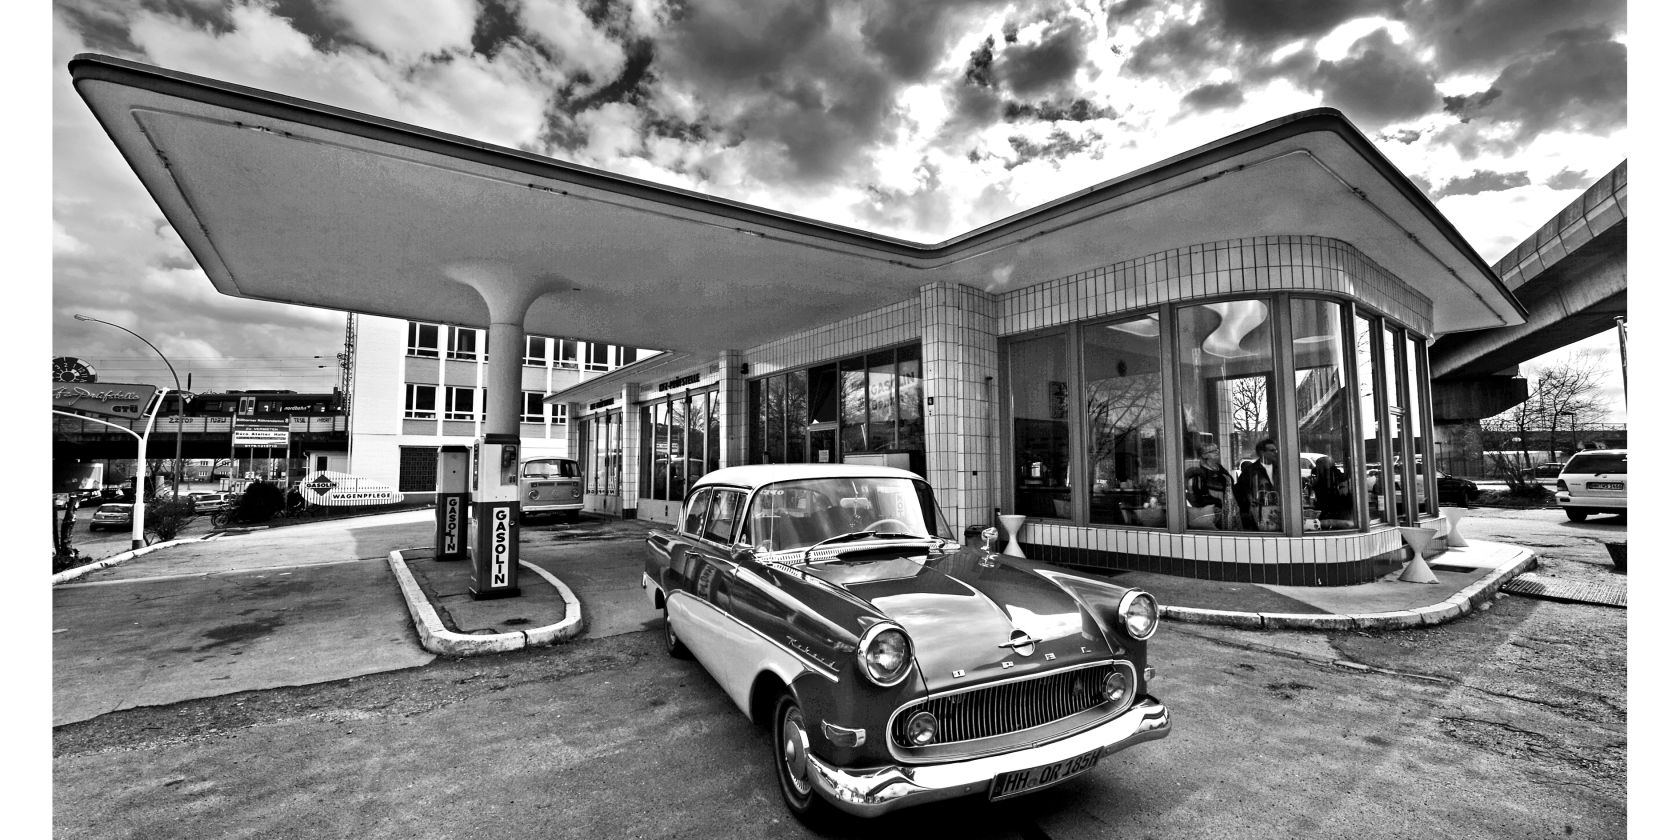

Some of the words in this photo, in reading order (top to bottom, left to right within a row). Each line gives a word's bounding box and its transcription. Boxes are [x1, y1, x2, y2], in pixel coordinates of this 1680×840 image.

[870, 371, 915, 396] GASIN
[111, 405, 139, 413] GTÜ
[332, 492, 391, 500] WAGENPFLEGE
[447, 498, 458, 552] GASOLIN
[494, 510, 507, 585] GASOLIN
[1003, 771, 1031, 793] HH
[1039, 763, 1063, 785] OR
[1062, 749, 1101, 778] 185H
